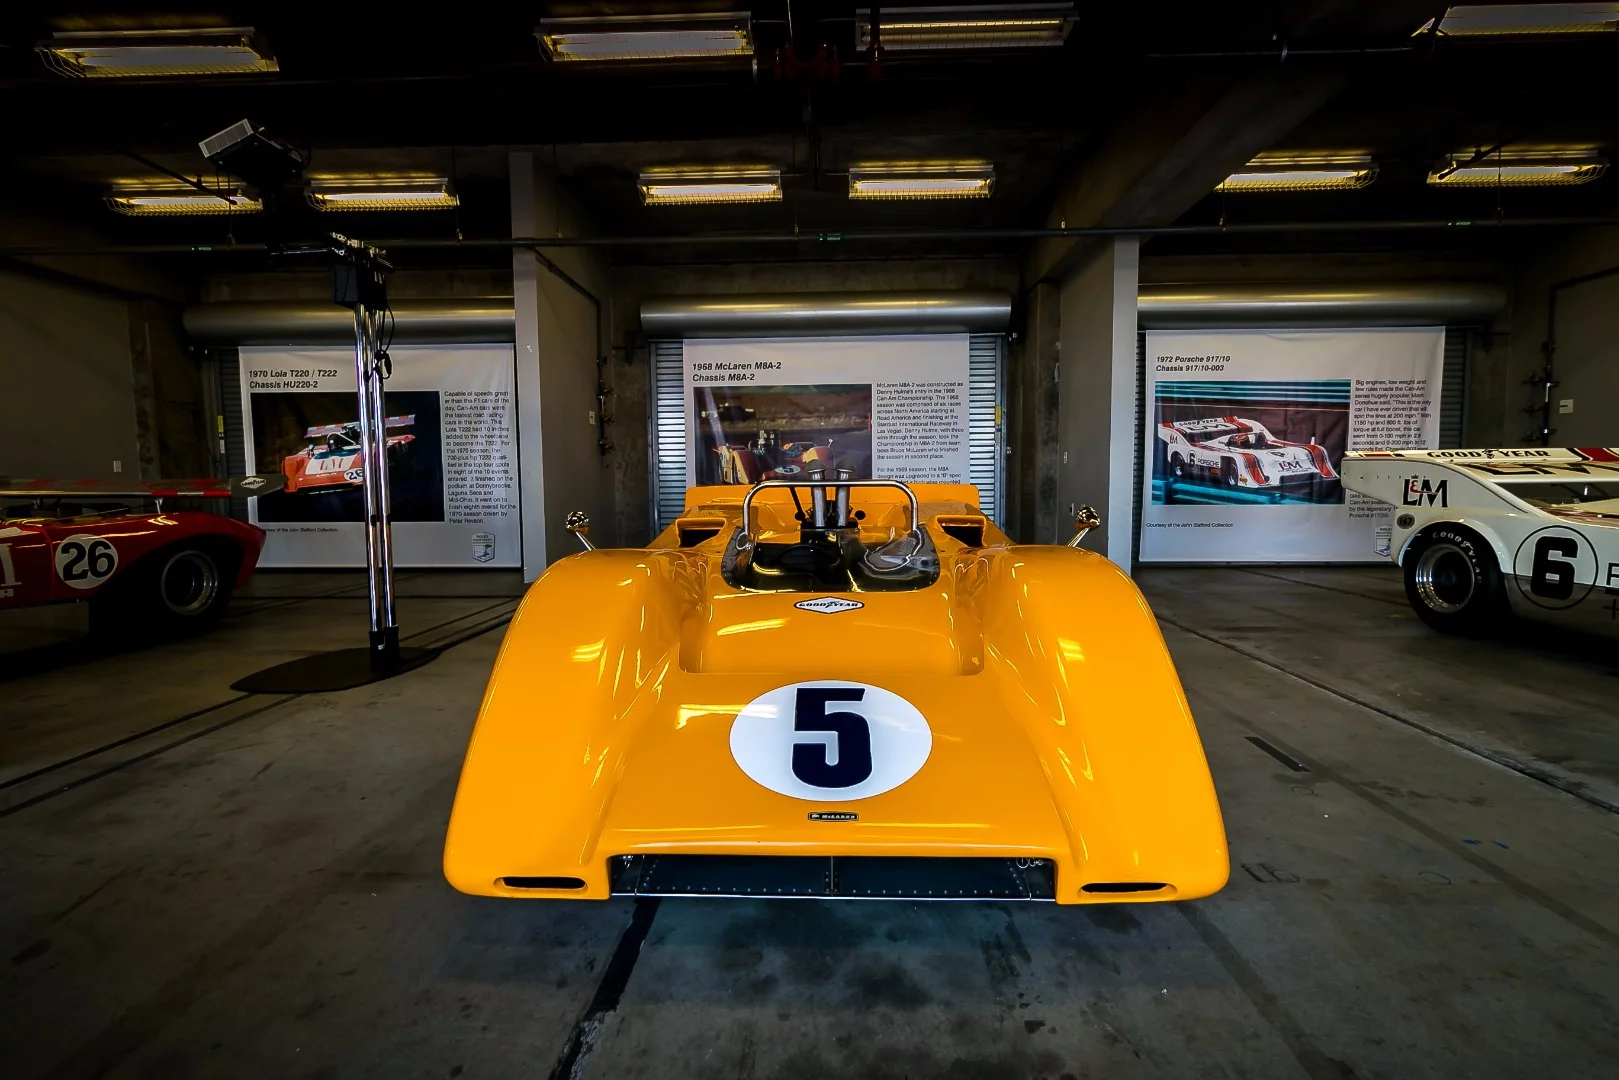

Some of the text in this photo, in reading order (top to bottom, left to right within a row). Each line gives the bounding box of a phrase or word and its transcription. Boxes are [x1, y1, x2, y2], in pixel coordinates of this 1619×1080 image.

[715, 362, 752, 370] McLaren
[782, 464, 794, 472] 5
[1189, 453, 1196, 467] 6
[1198, 458, 1219, 467] PORSCHE
[1402, 478, 1448, 508] L&M
[61, 541, 115, 581] 26
[1530, 536, 1579, 600] 6
[792, 687, 872, 788] 5
